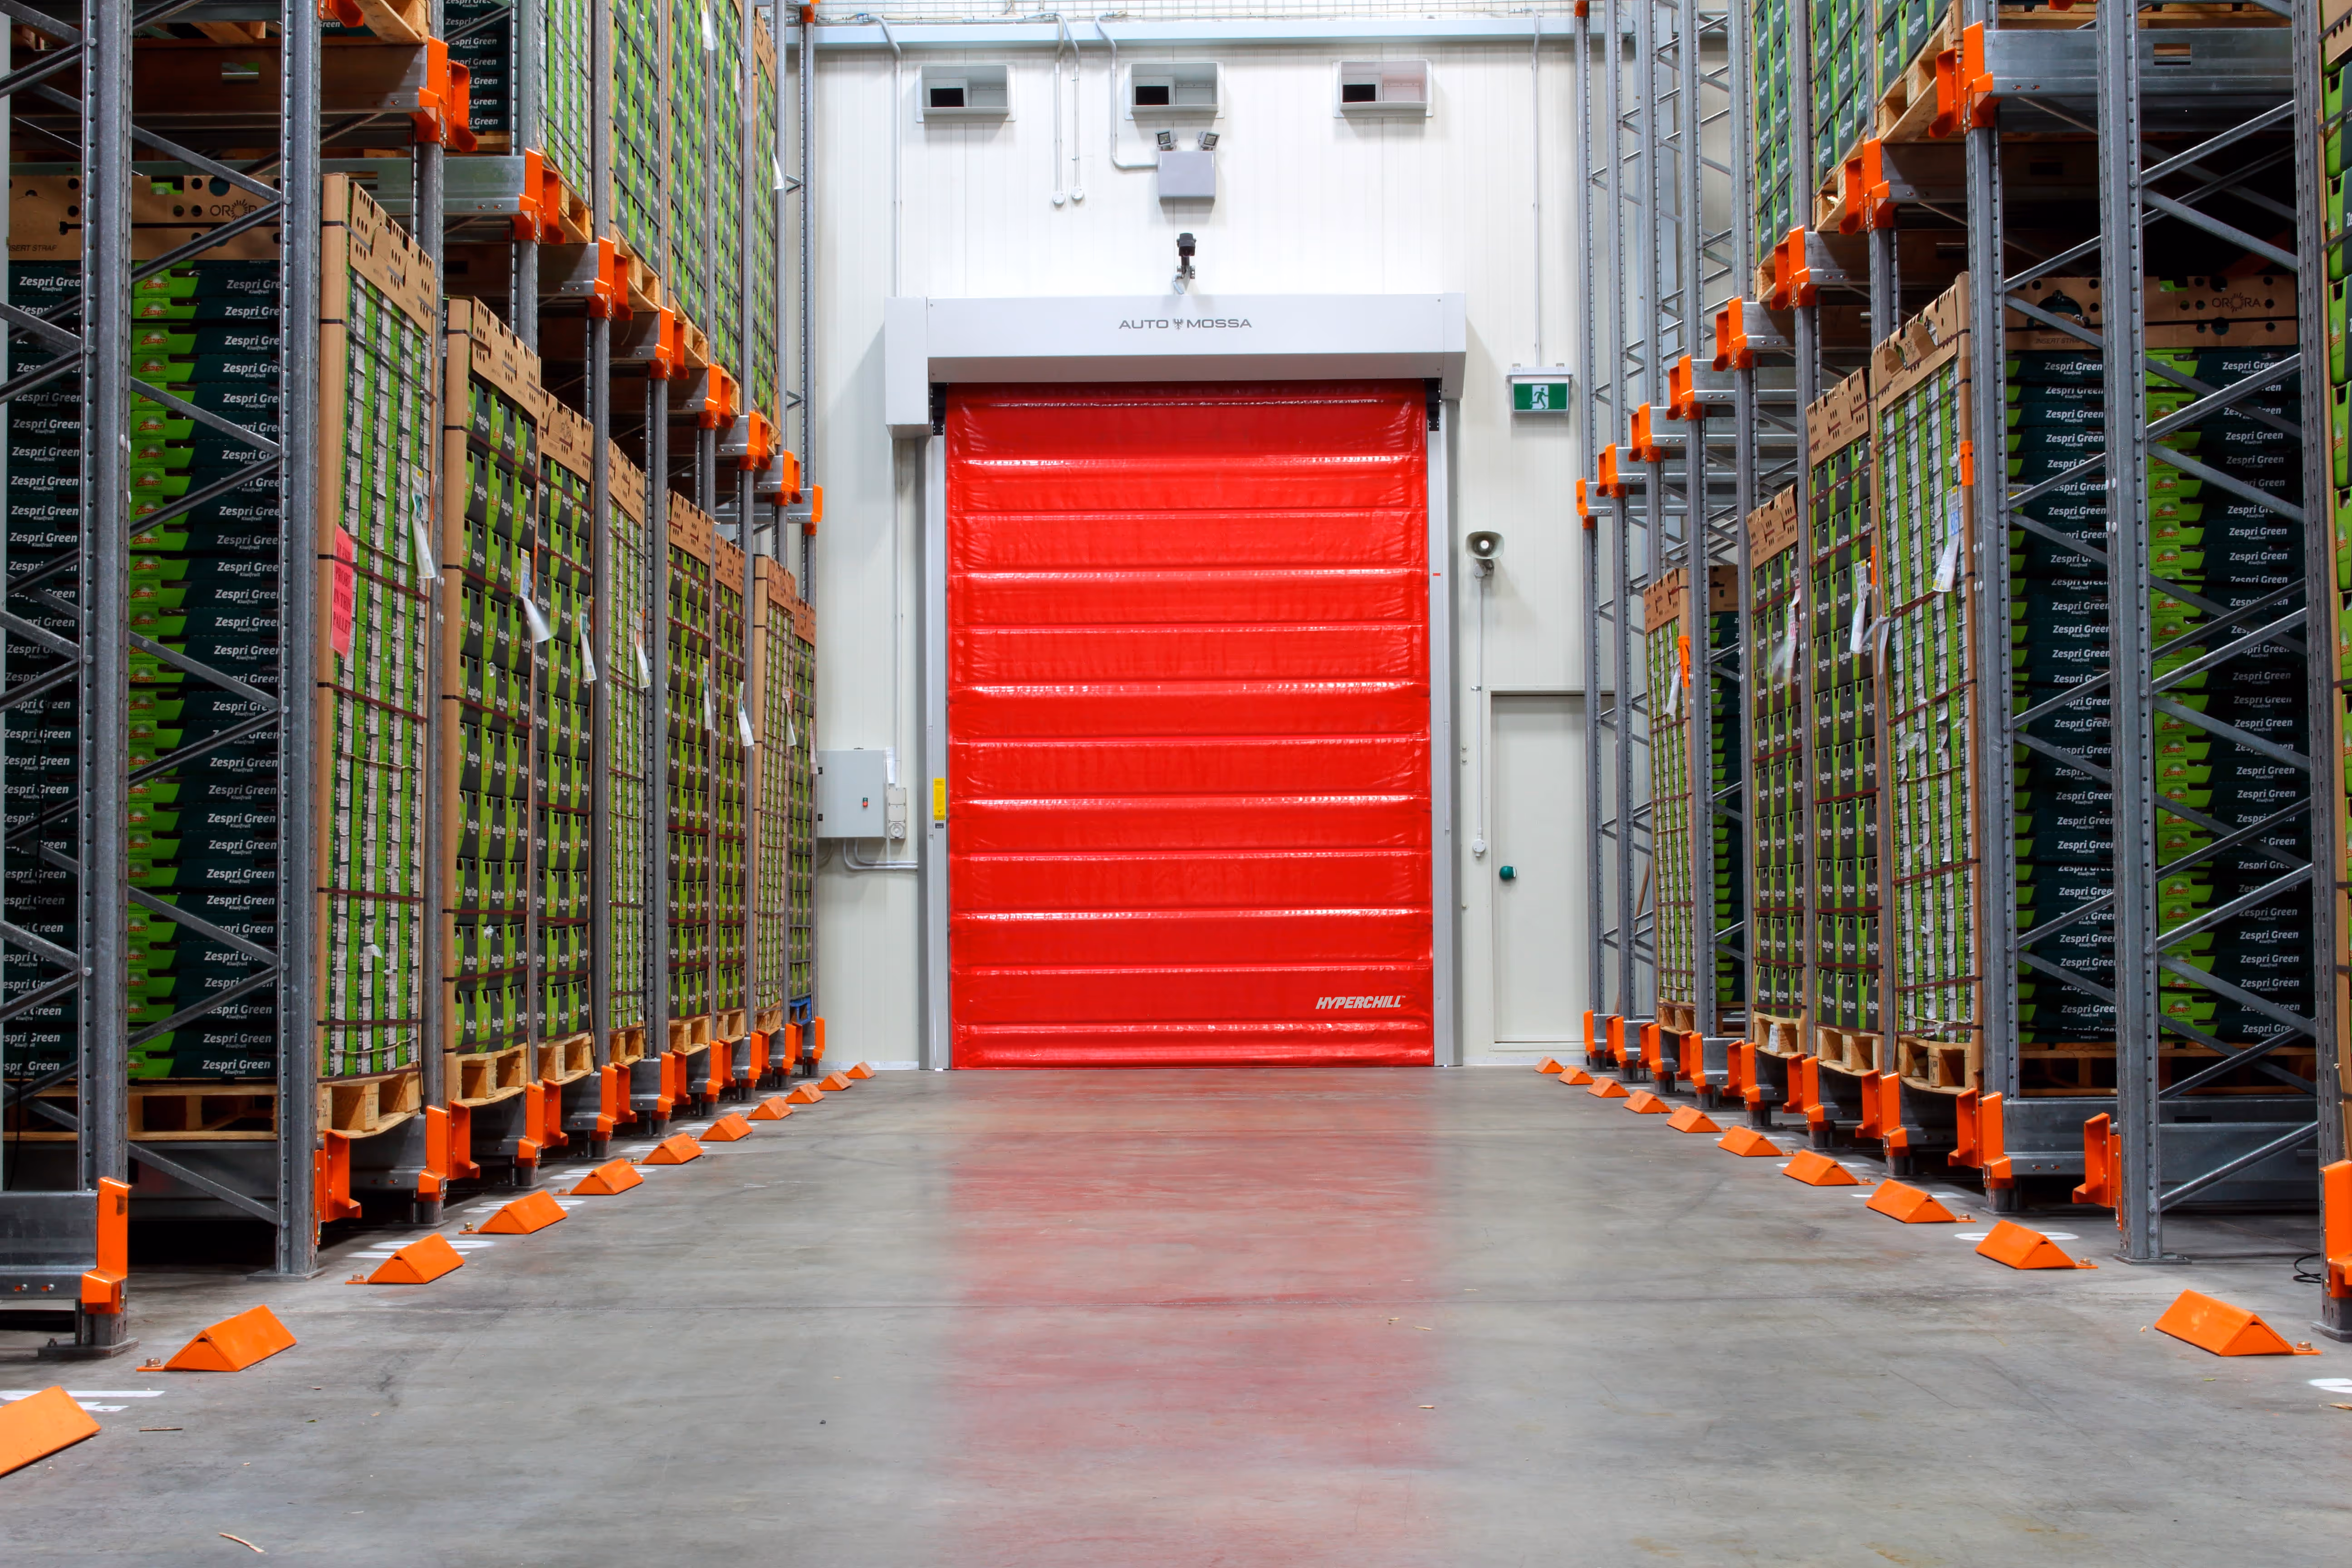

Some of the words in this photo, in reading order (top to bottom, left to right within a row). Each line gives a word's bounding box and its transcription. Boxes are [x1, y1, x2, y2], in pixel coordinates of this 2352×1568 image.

[475, 117, 498, 125] Green
[20, 277, 53, 287] Zespri
[56, 277, 81, 286] Gree
[142, 279, 169, 289] Zespri
[226, 280, 260, 290] Zespri
[141, 307, 168, 317] Zespri
[225, 306, 258, 316] Zespri
[1119, 319, 1169, 329] AUTO
[1186, 318, 1252, 328] MOSSA
[141, 335, 167, 345] Zespri
[225, 335, 258, 346] Zespri
[223, 363, 256, 374] Zespri
[2045, 362, 2074, 372] Zespri
[2076, 362, 2103, 370] Green
[2222, 361, 2251, 371] Zespri
[223, 393, 256, 404] Zespri
[2046, 409, 2075, 419] Zespri
[2077, 409, 2104, 417] Green
[13, 419, 46, 429] Zespri
[50, 419, 81, 428] Green
[138, 421, 165, 431] Zespri
[2046, 433, 2075, 443] Zespri
[2078, 433, 2104, 441] Green
[2225, 432, 2254, 441] Zespri
[2257, 432, 2284, 440] Green
[12, 447, 45, 457] Zespri
[49, 447, 80, 456] Green
[222, 450, 255, 461] Zespri
[2227, 456, 2256, 465] Zespri
[2259, 456, 2285, 464] Green
[11, 476, 44, 486] Zespri
[48, 476, 79, 485] Green
[2079, 481, 2106, 490] Green
[11, 505, 44, 516] Zespri
[48, 505, 79, 515] Green
[219, 507, 252, 517] Zespri
[2048, 505, 2077, 515] Zespri
[2079, 505, 2106, 514] Green
[2155, 509, 2178, 518] Zespri
[2156, 529, 2180, 539] Zespri
[2229, 527, 2258, 537] Zespri
[2261, 527, 2288, 535] Green
[10, 533, 43, 544] Zespri
[46, 533, 78, 543] Green
[217, 535, 250, 546] Zespri
[2051, 554, 2080, 564] Zespri
[2156, 554, 2180, 563] Zespri
[2230, 552, 2259, 562] Zespri
[2261, 552, 2288, 560] Green
[134, 562, 161, 571] Zespri
[217, 562, 250, 573] Zespri
[215, 589, 248, 600] Zespri
[2052, 601, 2081, 611] Zespri
[44, 617, 75, 627] Green
[215, 617, 248, 627] Zespri
[2053, 625, 2082, 634] Zespri
[214, 645, 247, 656] Zespri
[2052, 649, 2081, 658] Zespri
[2233, 672, 2262, 682] Zespri
[2265, 672, 2292, 681] Green
[213, 701, 246, 712] Zespri
[2054, 718, 2083, 728] Zespri
[2234, 719, 2264, 728] Zespri
[2266, 719, 2293, 727] Green
[2162, 746, 2185, 755] Zespri
[40, 756, 71, 766] Green
[210, 758, 243, 768] Zespri
[247, 758, 278, 767] Green
[2163, 768, 2186, 777] Zespri
[2236, 766, 2265, 776] Zespri
[2268, 766, 2295, 774] Green
[208, 785, 241, 796] Zespri
[245, 785, 276, 795] Green
[2237, 790, 2266, 799] Zespri
[2269, 790, 2296, 798] Green
[207, 813, 240, 824] Zespri
[244, 813, 275, 823] Green
[2057, 816, 2086, 825] Zespri
[209, 840, 242, 850] Zespri
[245, 840, 277, 849] Green
[2058, 840, 2087, 849] Zespri
[2269, 837, 2296, 845] Green
[207, 869, 240, 879] Zespri
[244, 869, 275, 878] Green
[207, 895, 240, 906] Zespri
[244, 895, 275, 905] Green
[2270, 907, 2297, 916] Green
[242, 924, 273, 933] Green
[2060, 934, 2089, 943] Zespri
[2091, 934, 2113, 942] Gree
[2240, 931, 2269, 940] Zespri
[2272, 931, 2298, 939] Green
[205, 951, 238, 961] Zespri
[2240, 954, 2269, 964] Zespri
[2272, 954, 2299, 962] Green
[2060, 958, 2089, 967] Zespri
[2092, 958, 2113, 966] Gree
[2241, 978, 2270, 988] Zespri
[2273, 978, 2299, 986] Green
[240, 1004, 271, 1014] Green
[2062, 1004, 2091, 1014] Zespri
[2093, 1004, 2113, 1013] Gree
[2243, 1024, 2272, 1033] Zespri
[203, 1034, 236, 1044] Zespri
[240, 1034, 271, 1044] Green
[29, 1062, 60, 1071] Green
[202, 1059, 235, 1070] Zespri
[239, 1059, 270, 1069] Green
